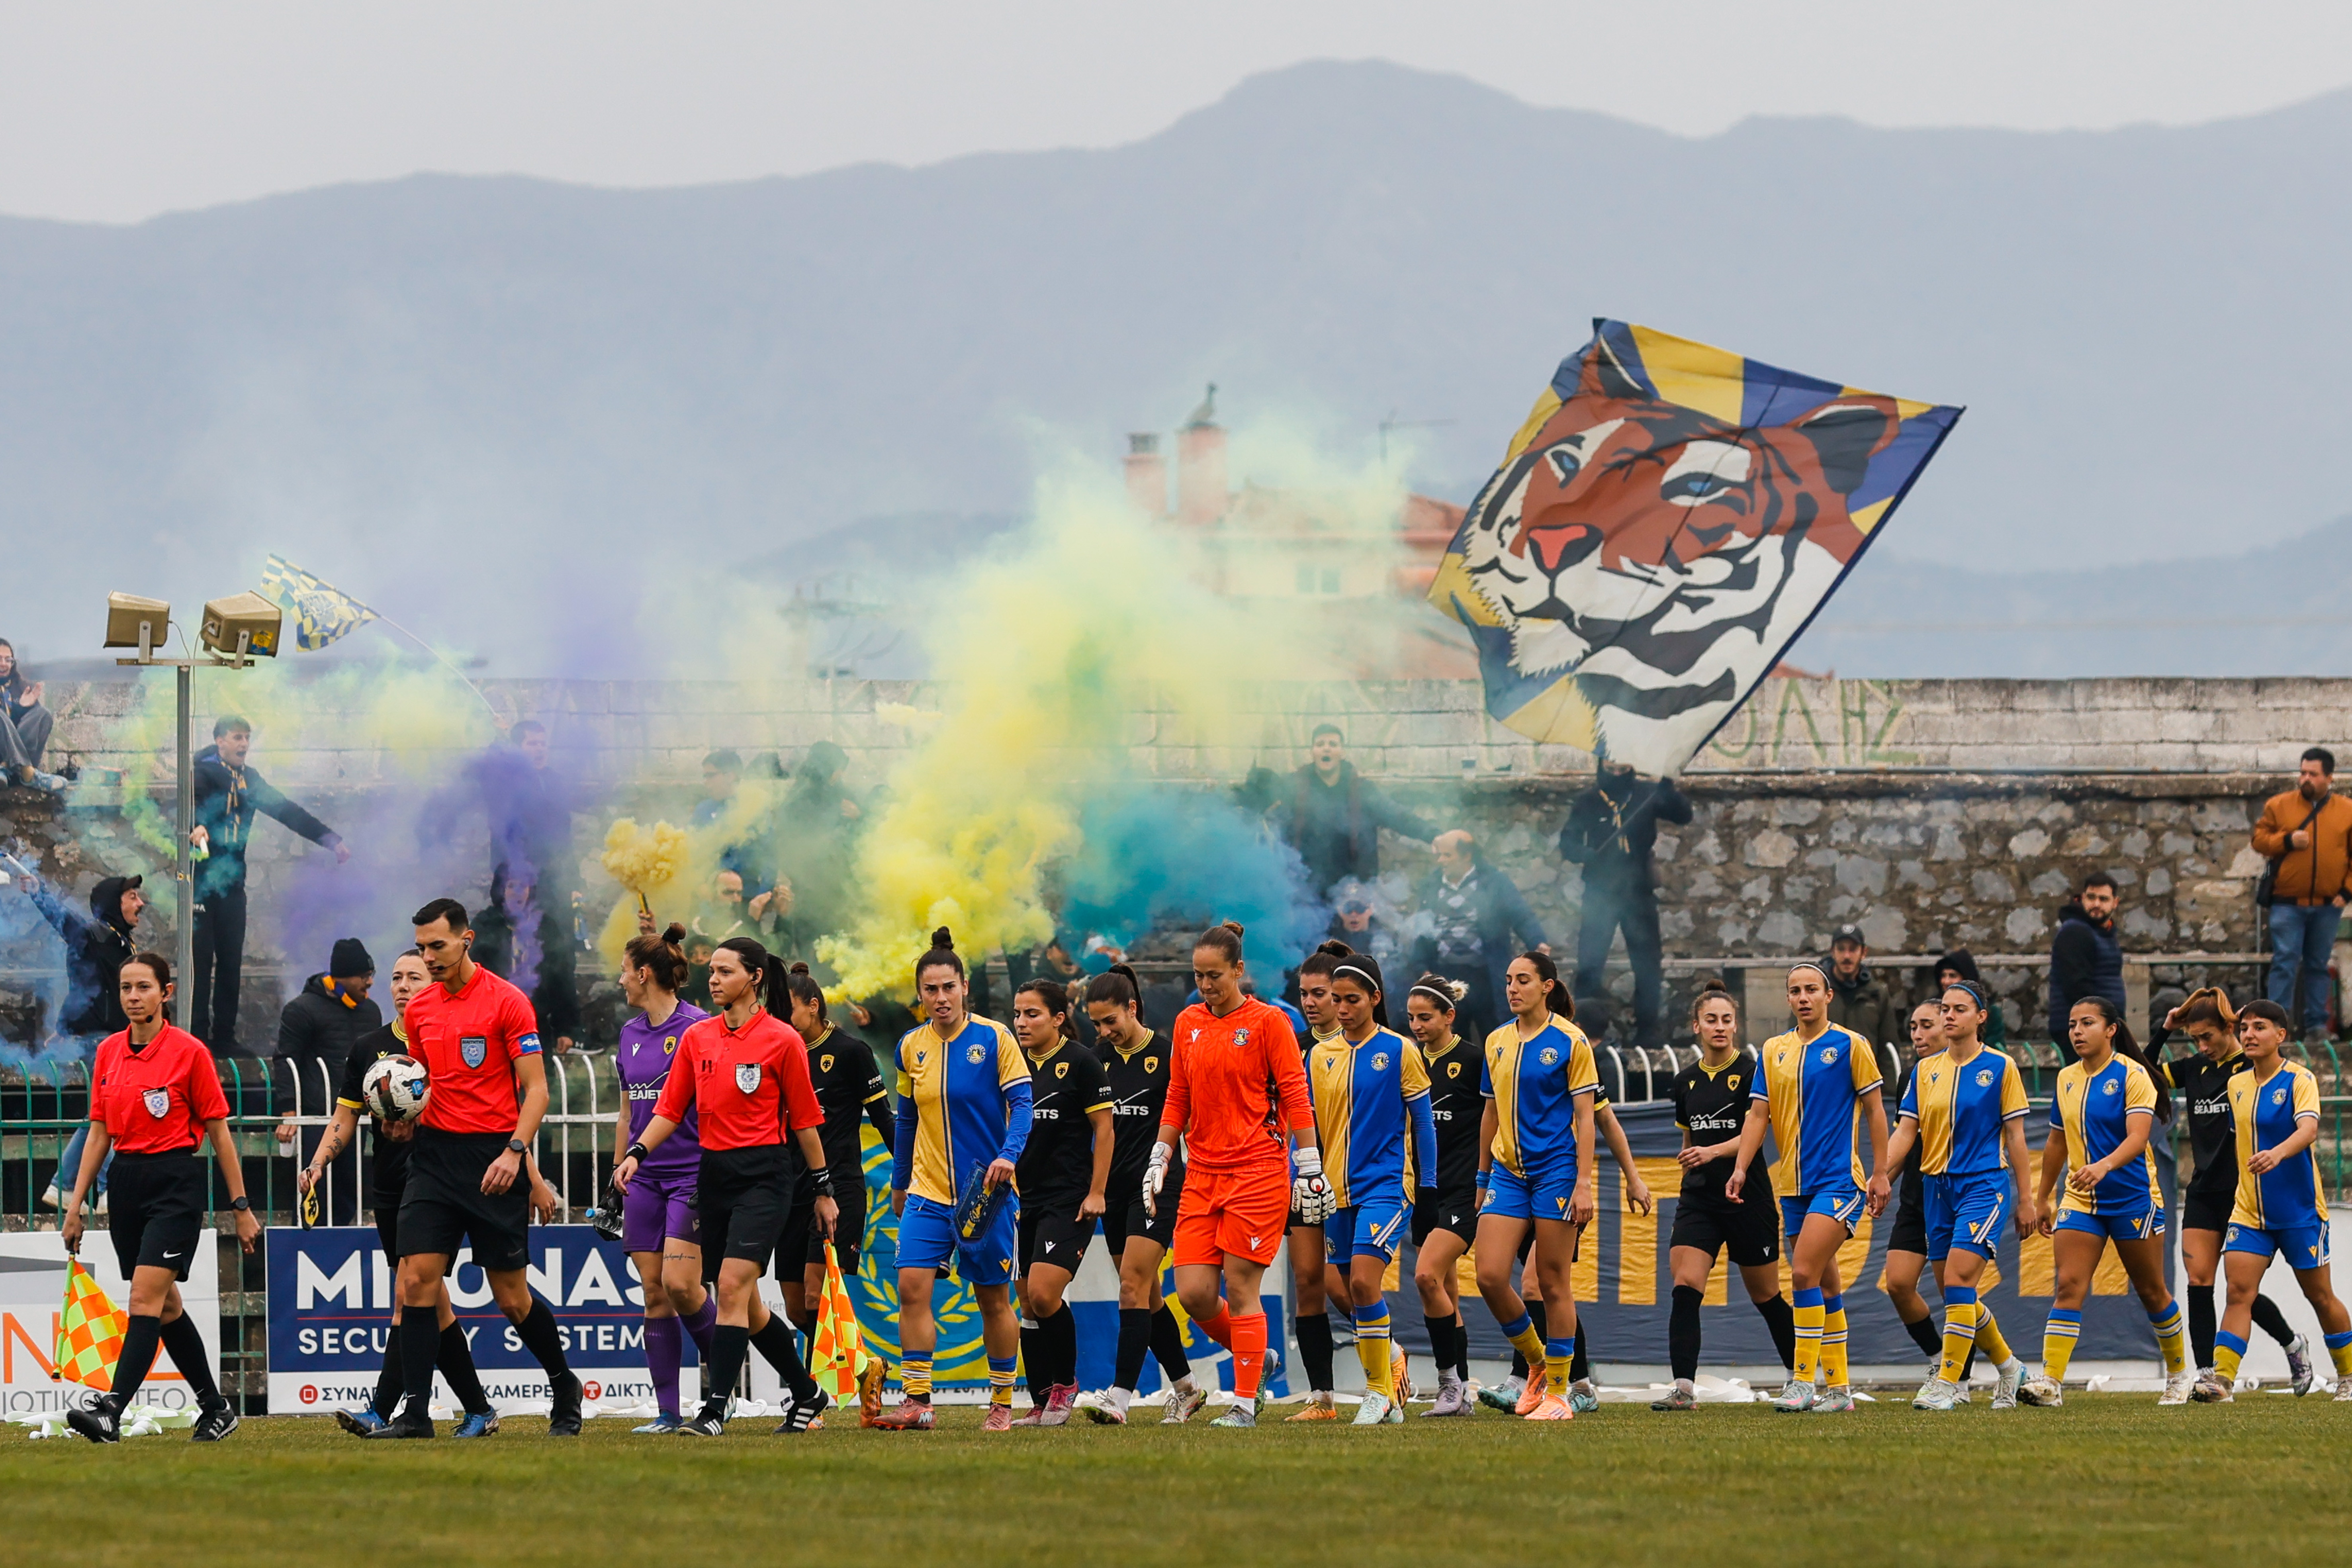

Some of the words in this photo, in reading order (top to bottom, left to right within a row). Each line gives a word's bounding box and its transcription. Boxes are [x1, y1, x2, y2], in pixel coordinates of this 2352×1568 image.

[296, 1248, 646, 1309] MIONAS
[299, 1326, 480, 1354] SECUY
[503, 1325, 646, 1352] SSTEM
